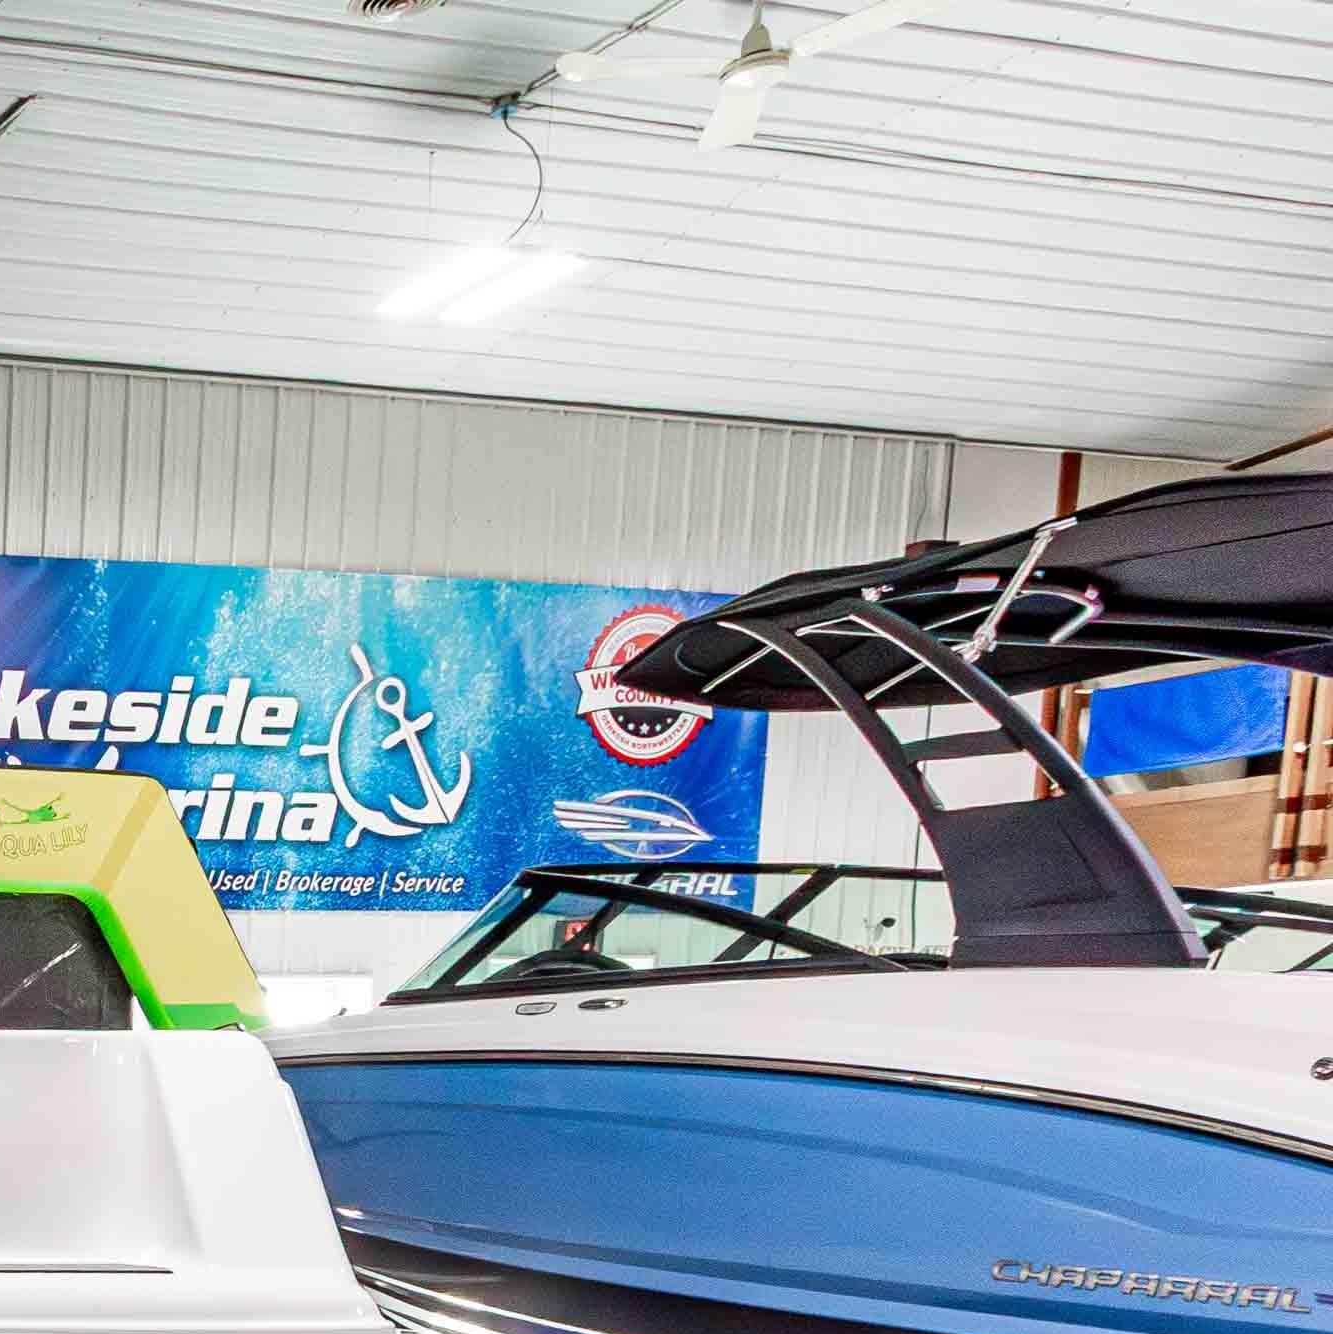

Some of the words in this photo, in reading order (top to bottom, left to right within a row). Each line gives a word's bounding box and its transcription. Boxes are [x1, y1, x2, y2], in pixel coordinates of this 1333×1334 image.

[167, 773, 338, 842] rina
[50, 824, 89, 852] LILY
[208, 871, 257, 891] Used
[275, 871, 375, 896] Brokerage
[392, 872, 464, 893] Service
[990, 1258, 1312, 1315] CHAPARRAL
